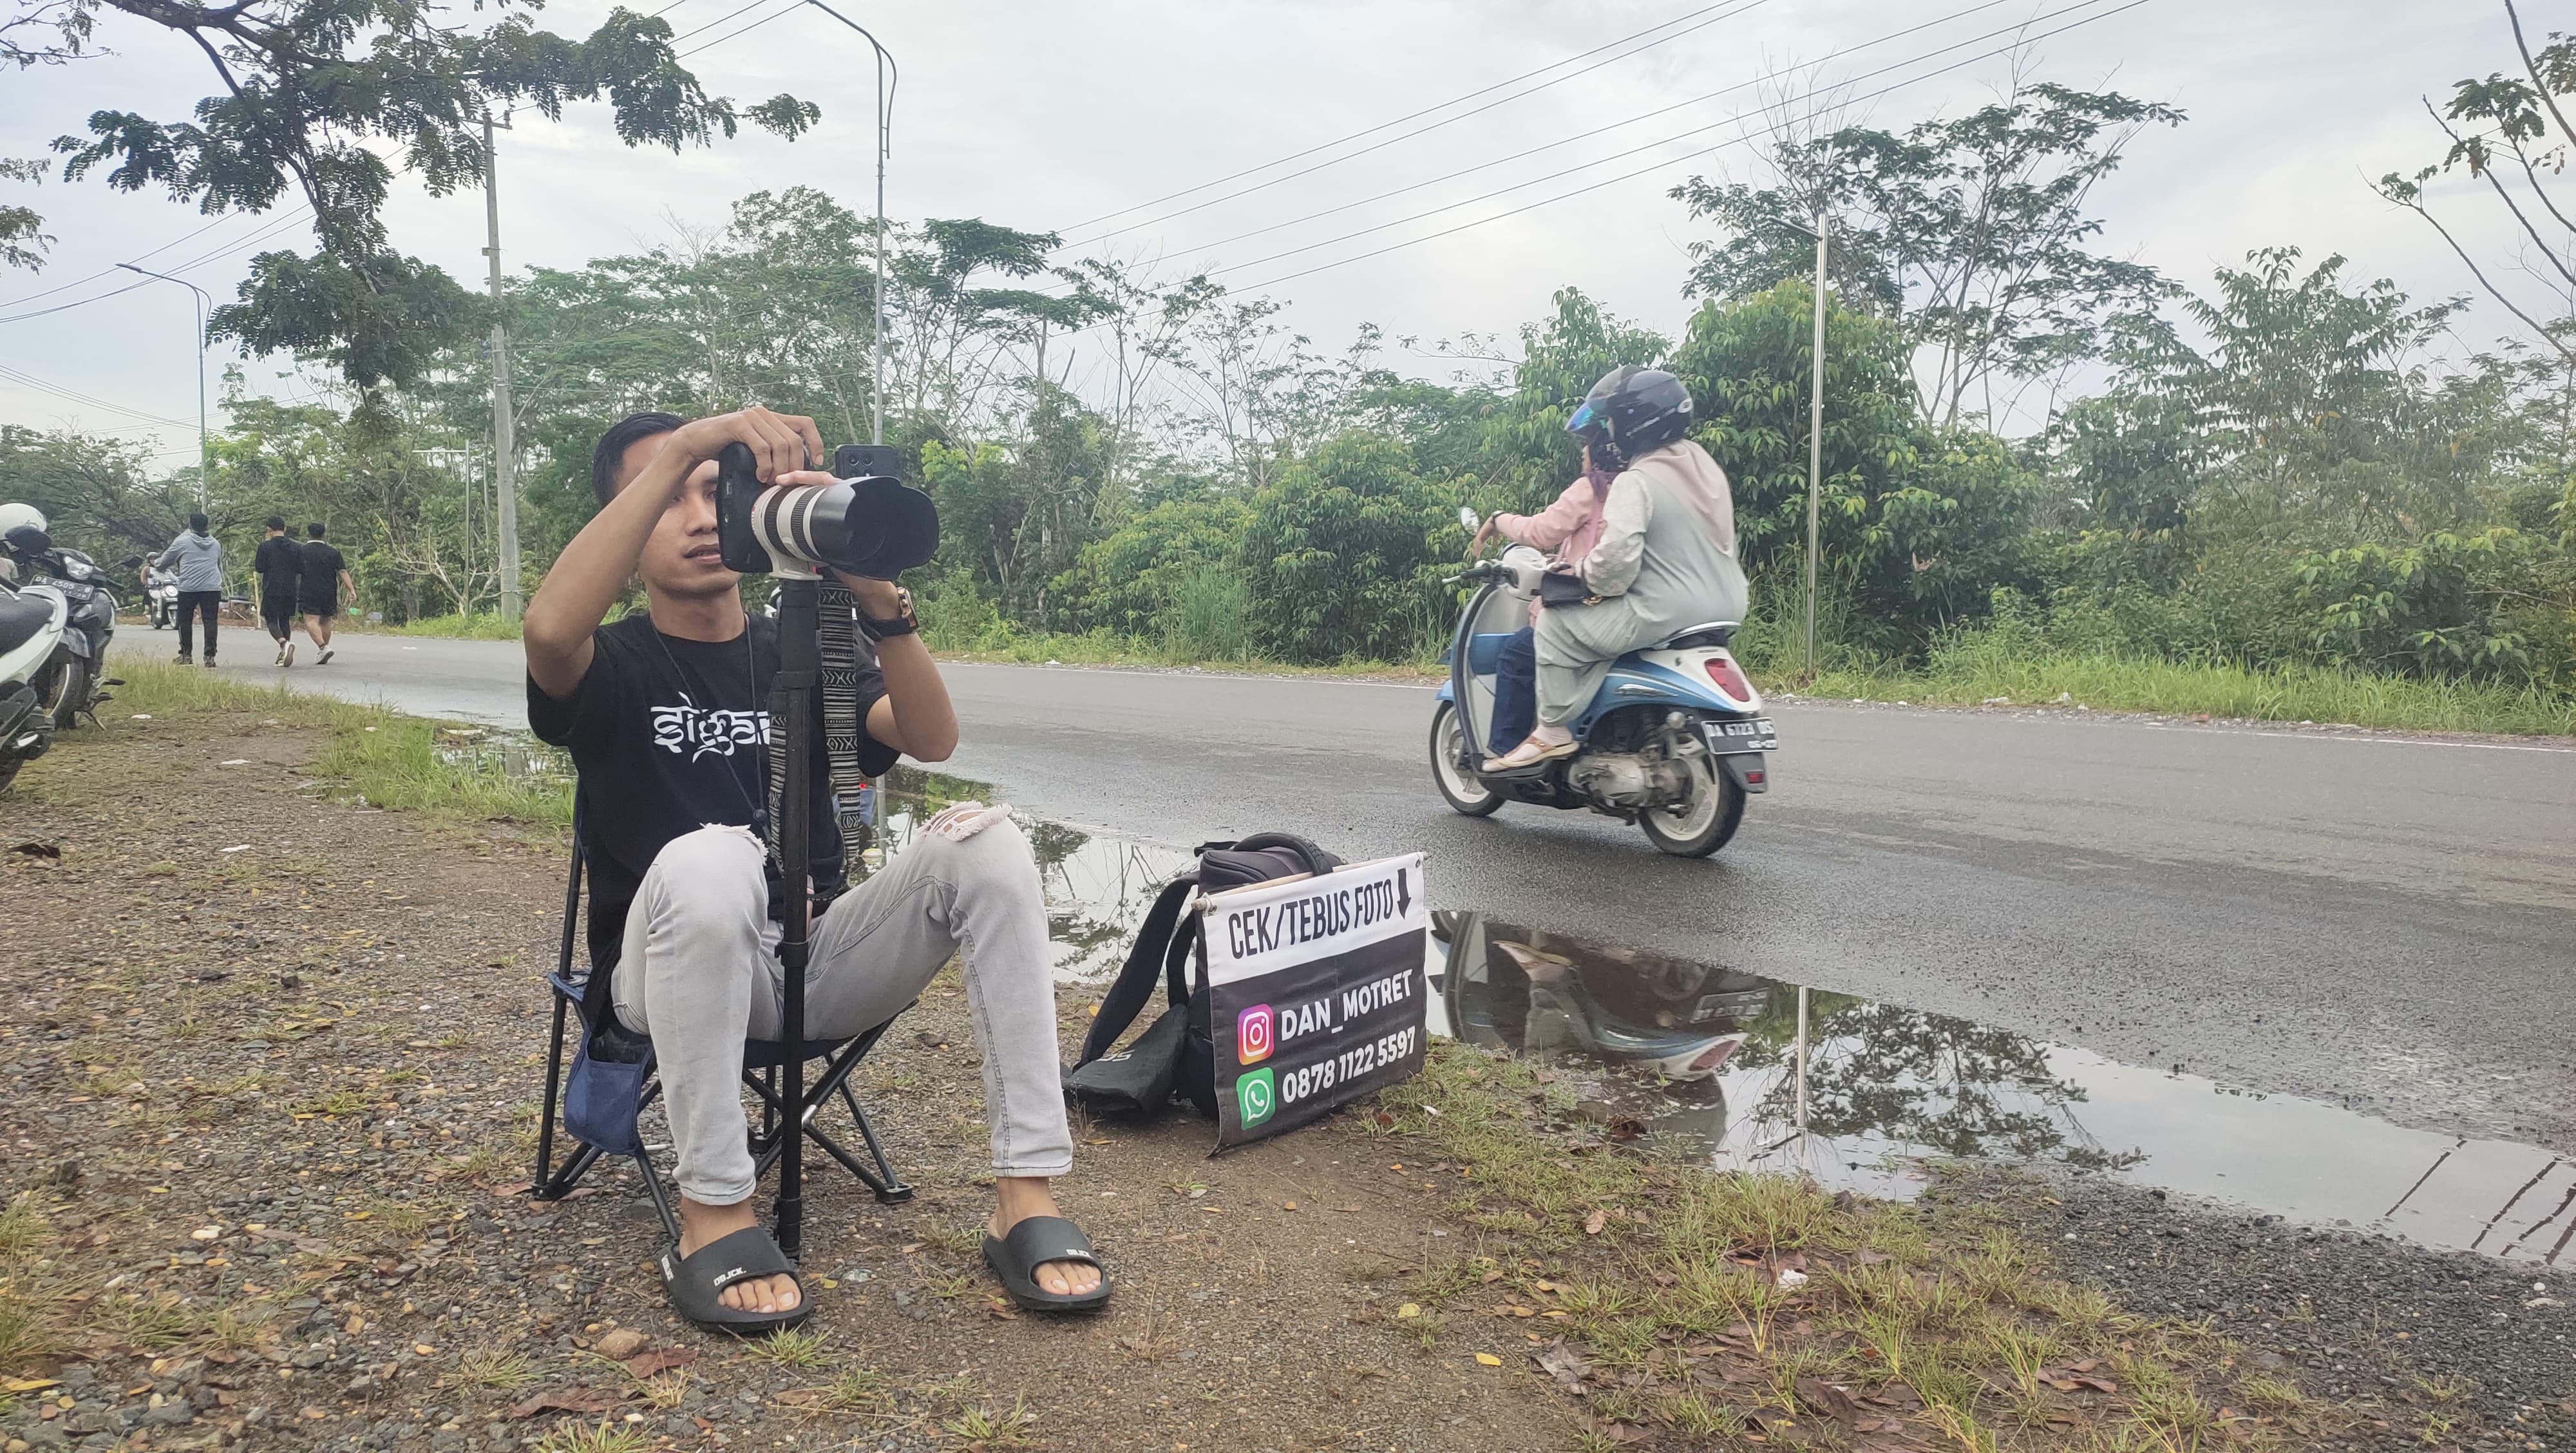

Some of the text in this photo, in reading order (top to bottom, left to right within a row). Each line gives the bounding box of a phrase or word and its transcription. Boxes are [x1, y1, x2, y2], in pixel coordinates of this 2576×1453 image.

[1228, 878, 1394, 960] CEK/TEBUS FOTO
[1280, 969, 1413, 1041] DAN_MOTRET
[1282, 1026, 1416, 1104] 0878 1122 5597
